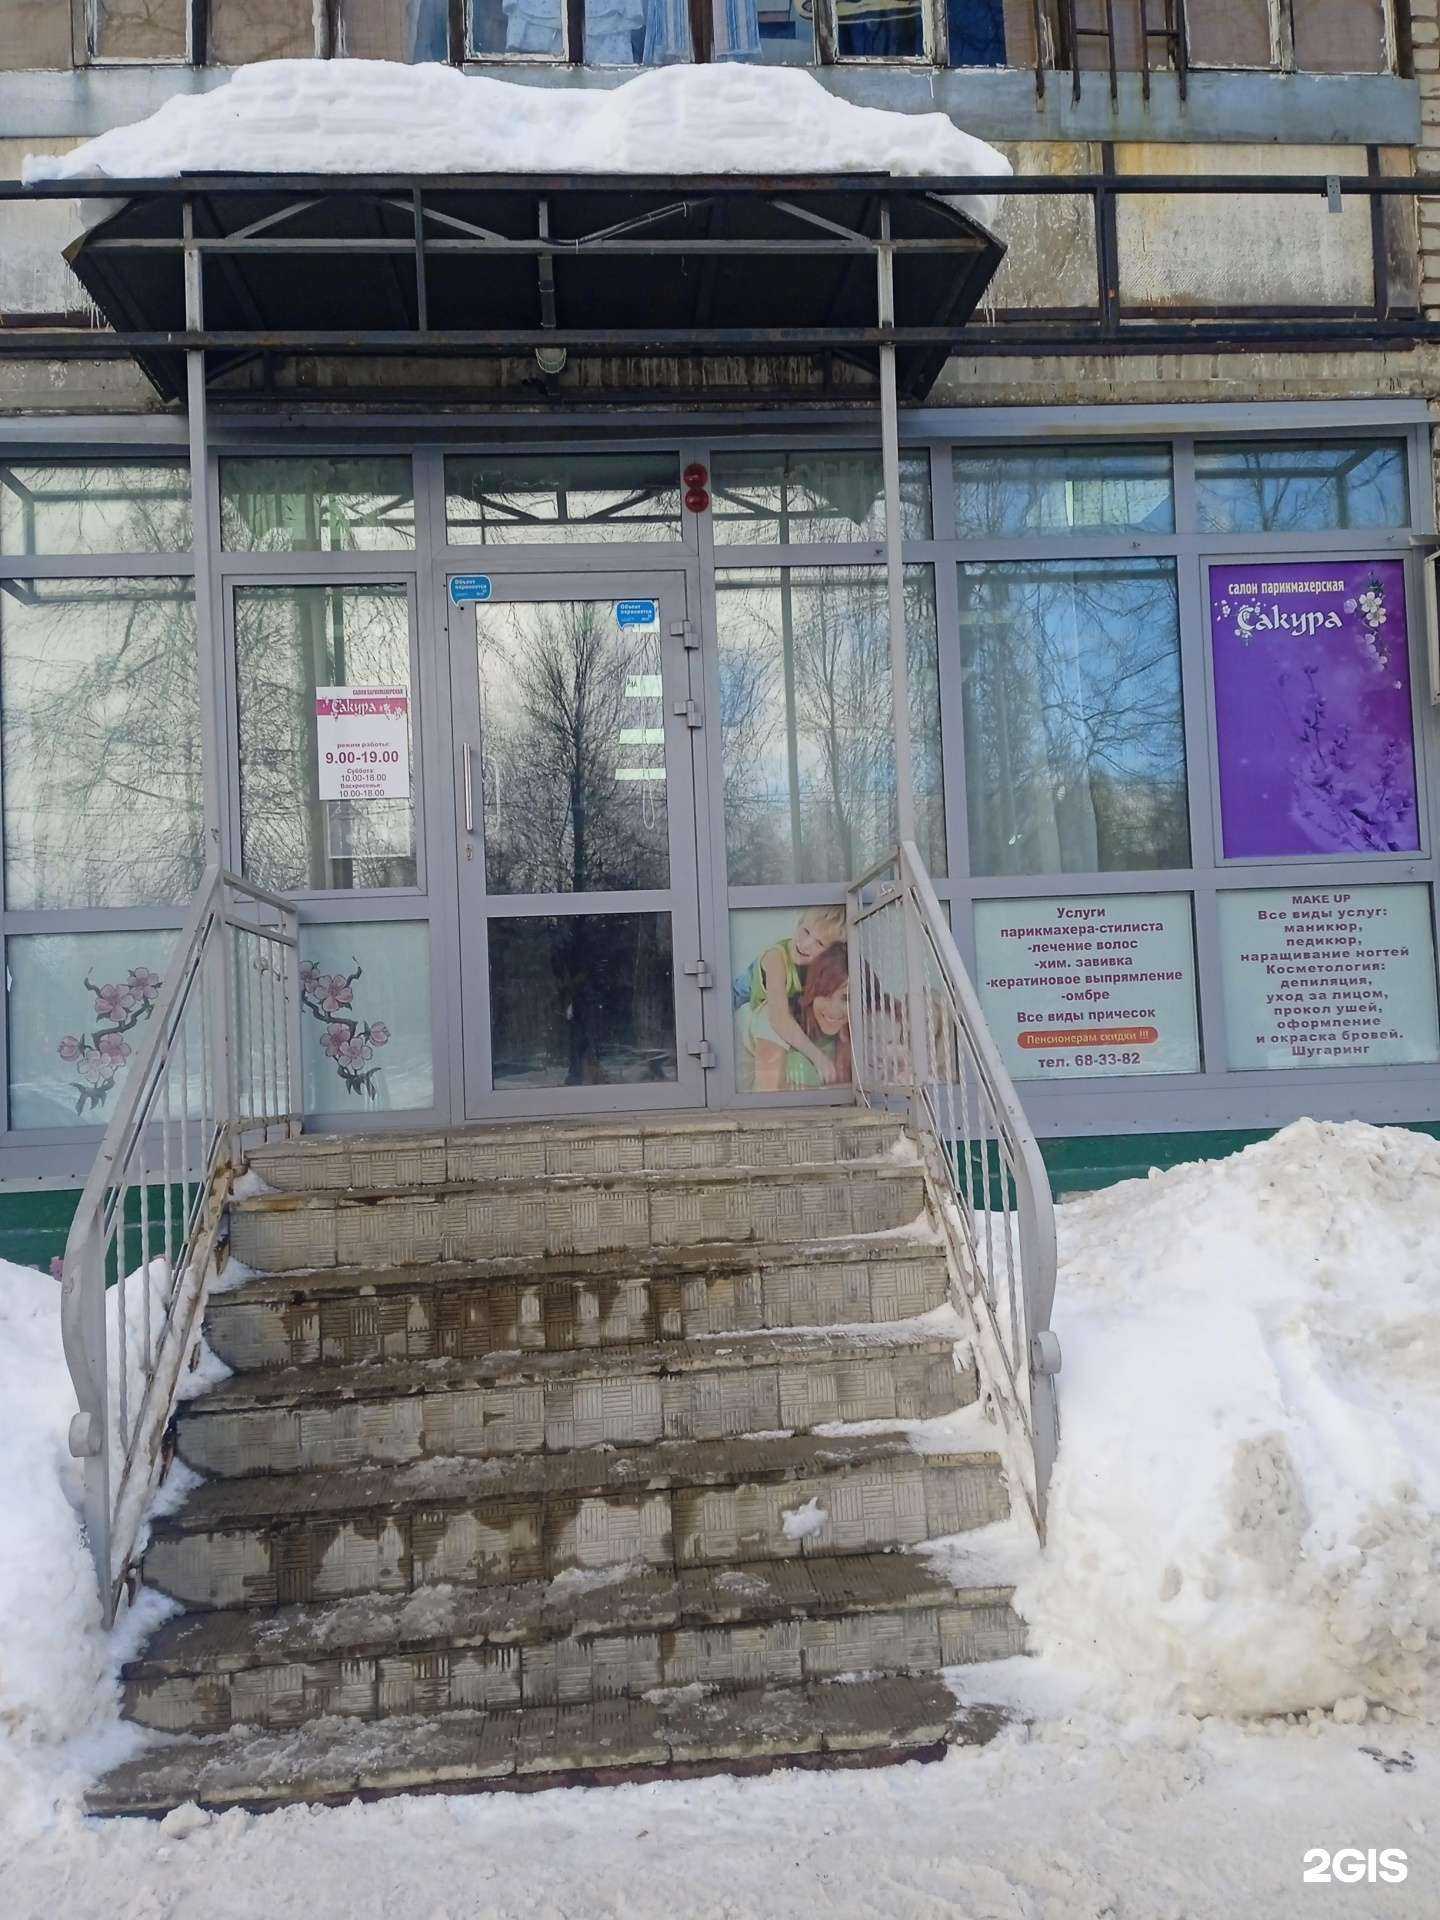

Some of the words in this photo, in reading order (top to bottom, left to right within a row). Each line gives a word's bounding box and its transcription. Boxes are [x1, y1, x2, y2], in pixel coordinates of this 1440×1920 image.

[1228, 582, 1258, 595] салон
[1261, 580, 1345, 596] парикмахерская
[1237, 604, 1343, 636] Сакура
[331, 699, 377, 716] Сакура
[325, 750, 399, 764] 9.00-19.00
[340, 789, 385, 797] 10.00-18.00
[1292, 895, 1330, 905] MAKE
[1333, 894, 1351, 903] UP
[1056, 907, 1106, 920] Услуги
[1258, 910, 1287, 920] Все
[1292, 909, 1332, 919] виды
[1338, 907, 1388, 919] услуг:
[1000, 922, 1164, 939] парикмахера-стилиста
[1284, 922, 1363, 933] маникюр,
[1027, 941, 1092, 953] -лечение
[1096, 939, 1139, 950] волос
[1286, 936, 1362, 947] педикюр,
[1240, 950, 1350, 963] наращивание
[1356, 947, 1409, 958] ногтей
[1034, 958, 1071, 969] -хим.
[1075, 956, 1133, 968] завивка
[1266, 963, 1386, 974] Косметология:
[985, 974, 1081, 990] -кератиновое
[1085, 970, 1182, 985] выпрямление
[1280, 977, 1373, 989] депиляция,
[1061, 990, 1111, 1003] -омбре
[1266, 993, 1304, 1004] уход
[1309, 992, 1327, 1000] за
[1332, 989, 1388, 1001] лицом,
[1017, 1012, 1043, 1023] Все
[1048, 1010, 1084, 1023] виды
[1088, 1008, 1156, 1021] причесок
[1274, 1006, 1331, 1017] прокол
[1336, 1003, 1383, 1015] ушей,
[1277, 1017, 1382, 1030] оформление
[1027, 1033, 1097, 1045] Пенсионерам
[1100, 1032, 1137, 1042] скидки
[1256, 1035, 1265, 1044] и
[1270, 1031, 1336, 1044] окраска
[1342, 1029, 1404, 1042] бровей.
[1292, 1045, 1371, 1058] Шугаринг
[1038, 1057, 1070, 1068] тел.
[1075, 1052, 1141, 1067] 68-33-82
